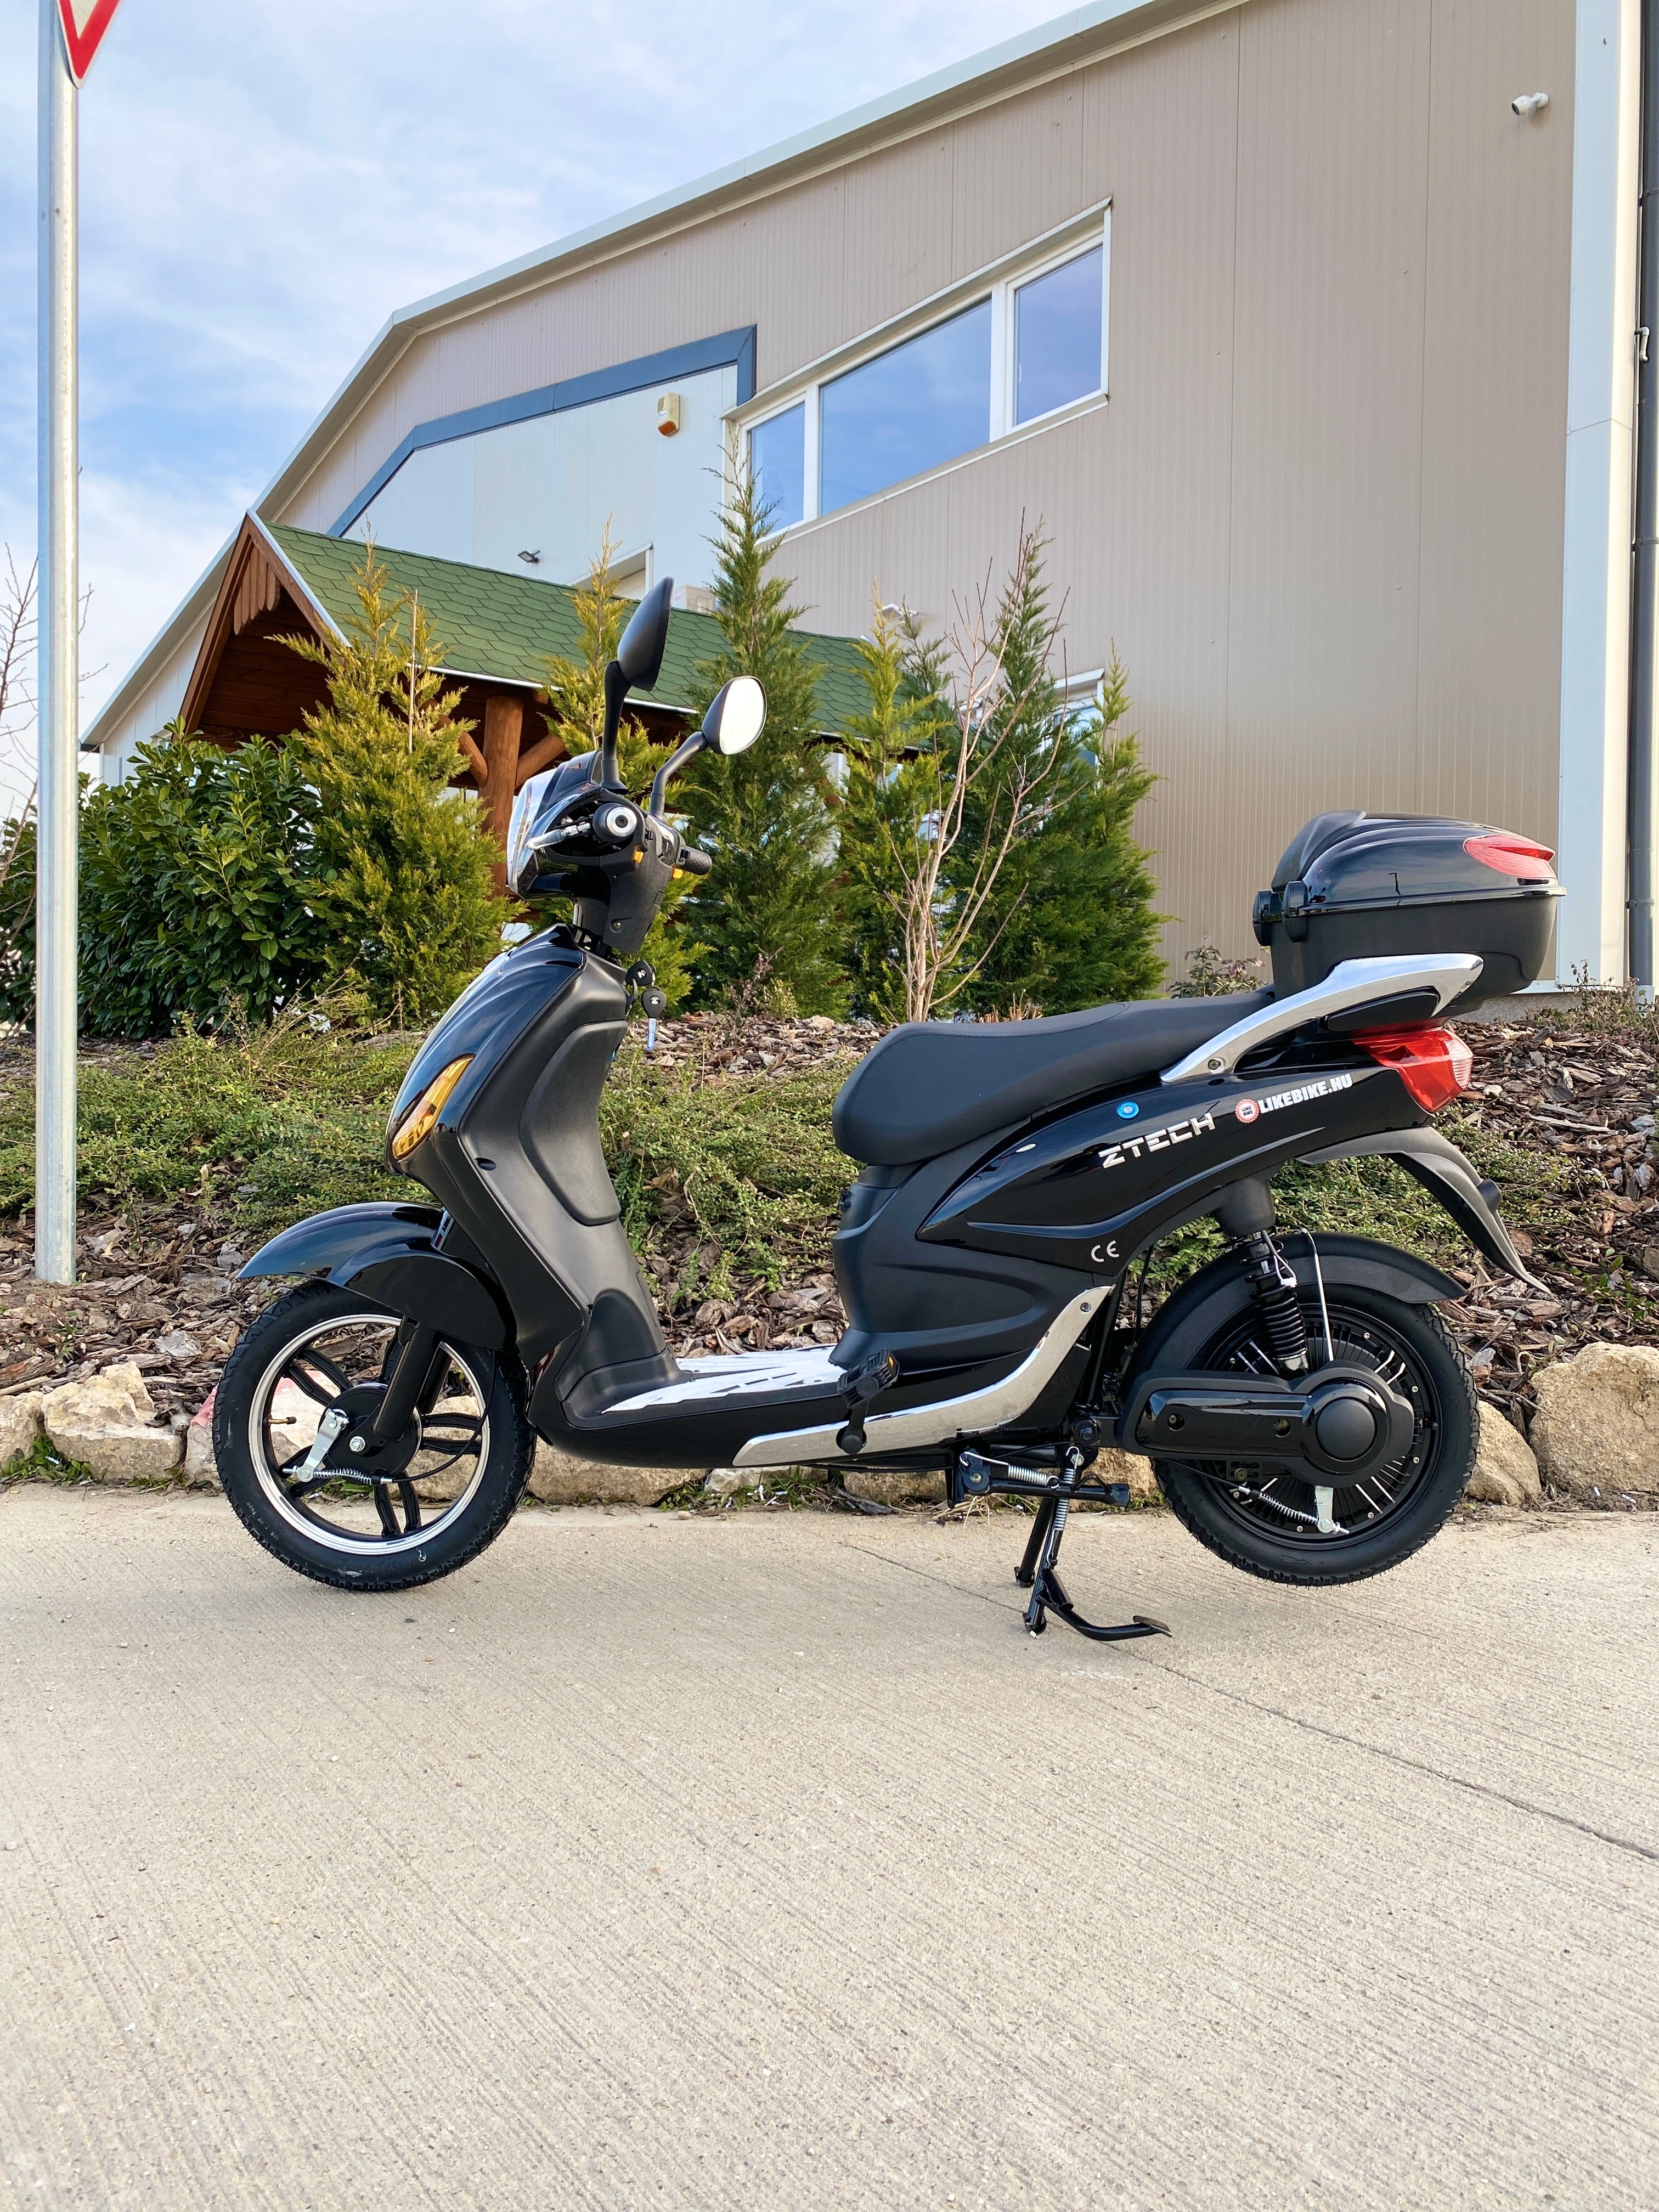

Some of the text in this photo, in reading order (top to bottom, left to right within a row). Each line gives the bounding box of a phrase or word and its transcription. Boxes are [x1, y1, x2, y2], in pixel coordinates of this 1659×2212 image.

[1258, 1074, 1353, 1114] LIKEBIKE.HU
[1098, 1112, 1216, 1169] ZTECH
[1091, 1240, 1120, 1262] CE
